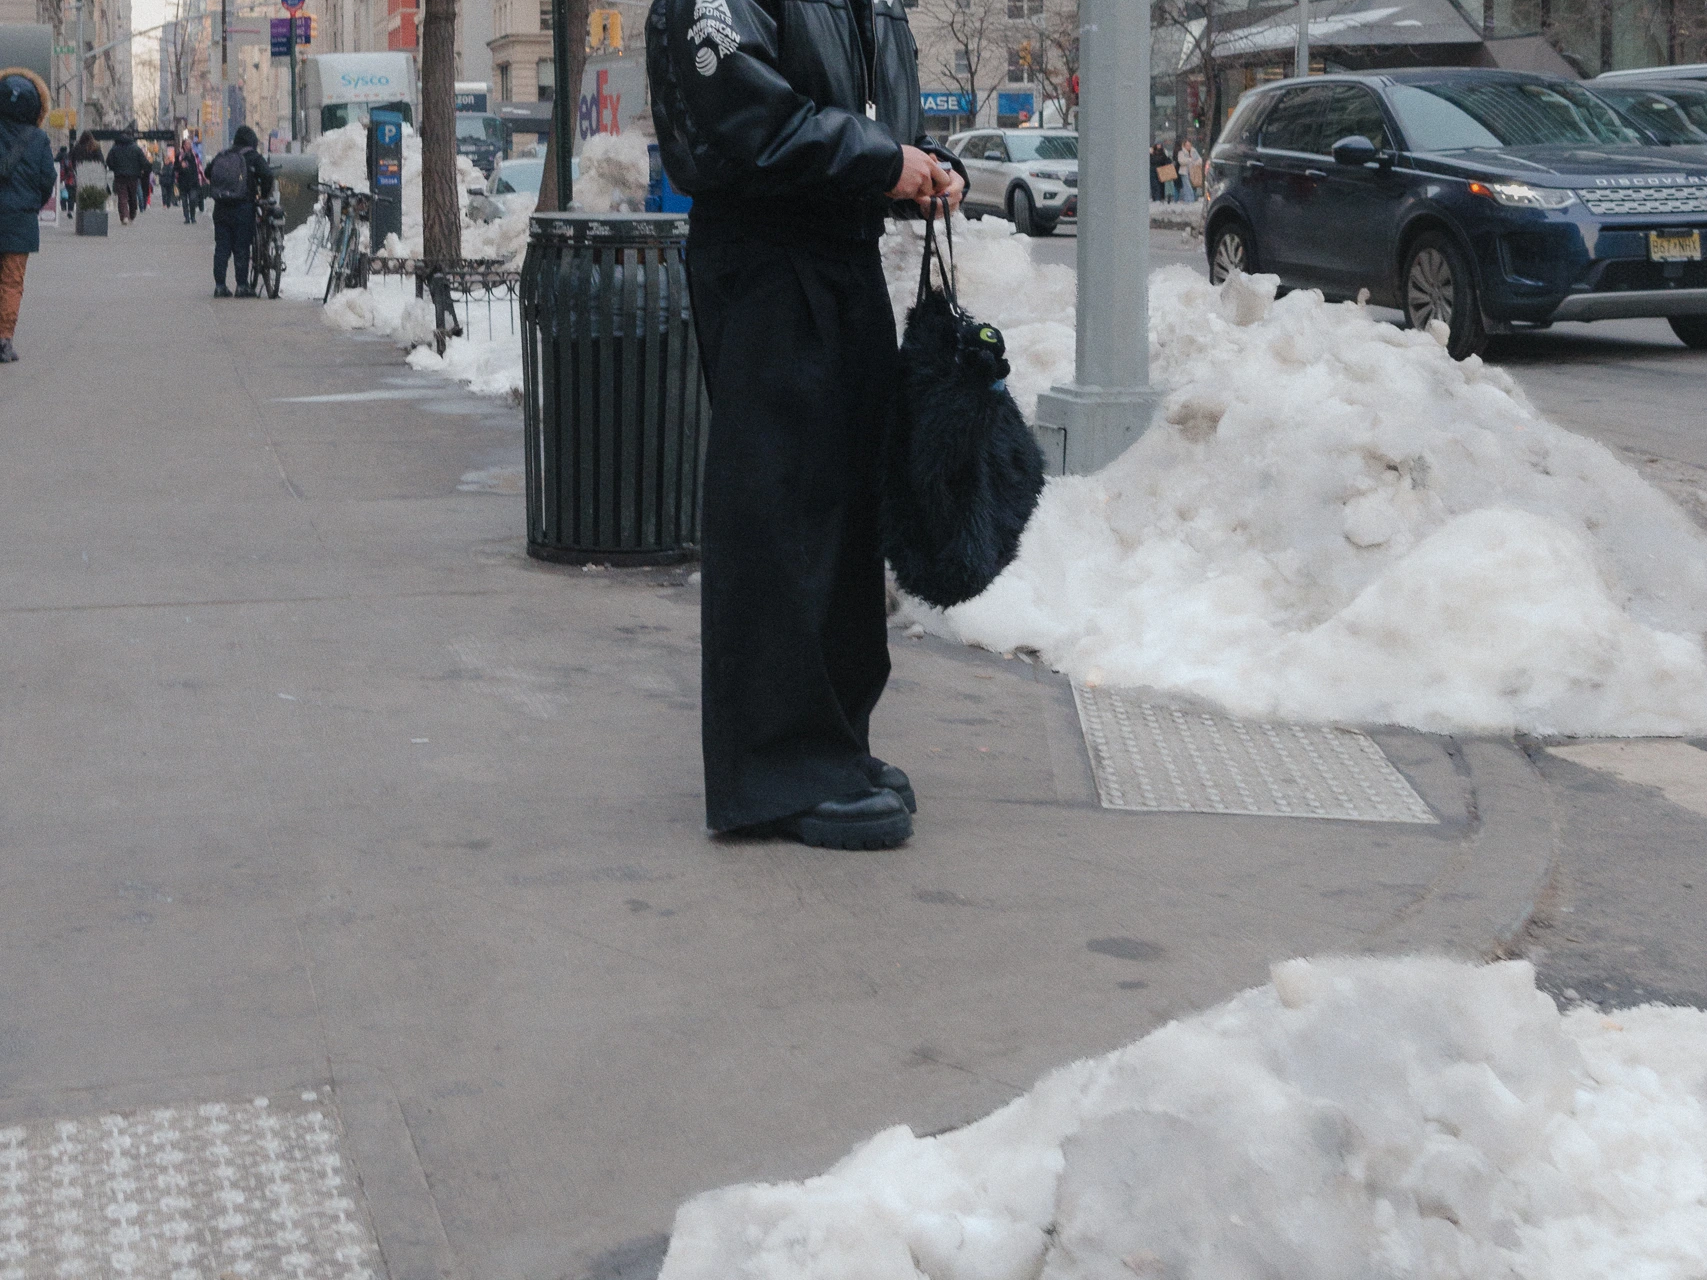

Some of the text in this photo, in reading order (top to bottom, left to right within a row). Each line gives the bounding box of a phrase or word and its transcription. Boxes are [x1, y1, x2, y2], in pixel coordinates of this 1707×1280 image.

[693, 6, 732, 26] SPORTS
[686, 19, 741, 44] AMERICAN
[340, 73, 390, 89] Sysco
[579, 69, 621, 141] edEx
[384, 124, 397, 143] P
